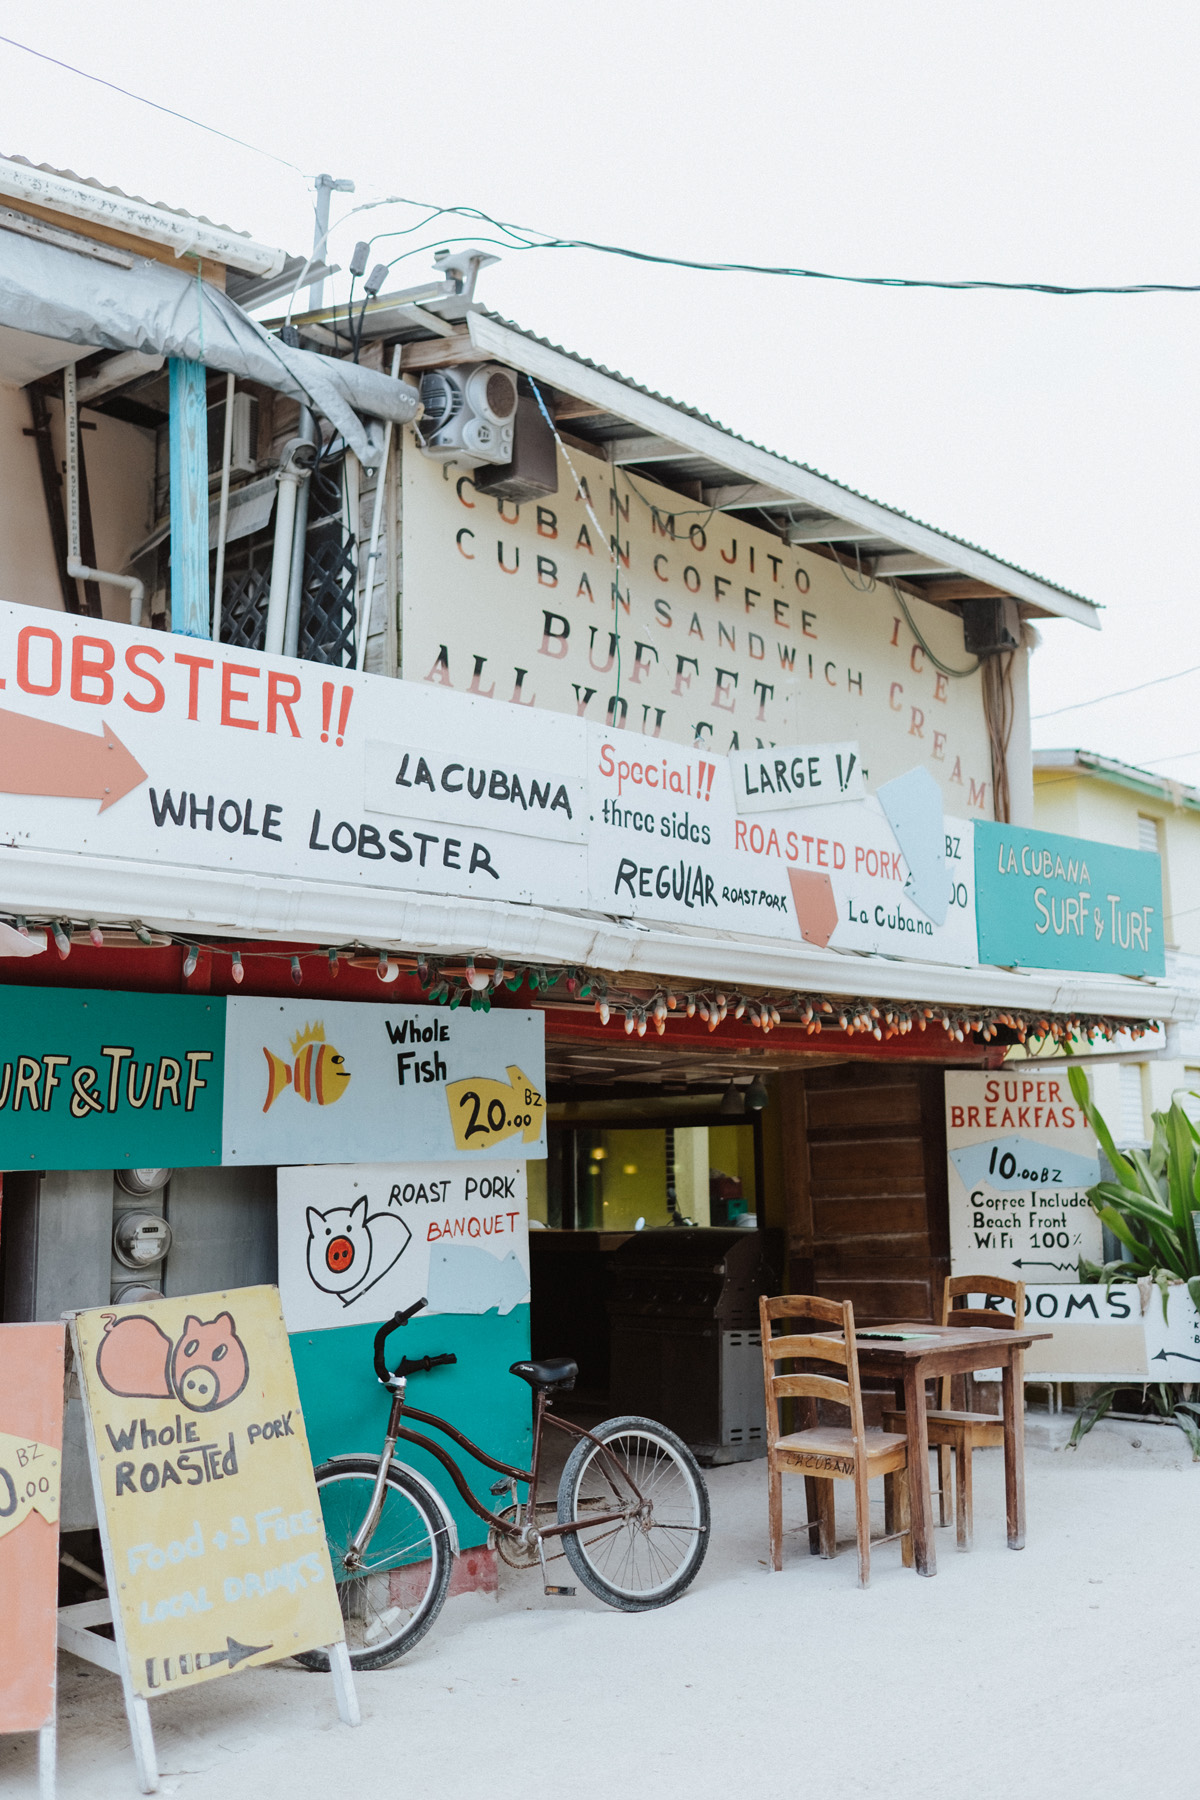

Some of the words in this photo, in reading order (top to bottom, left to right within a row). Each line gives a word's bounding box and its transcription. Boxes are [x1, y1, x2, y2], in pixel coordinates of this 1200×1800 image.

[651, 505, 811, 594] MOJITO
[456, 528, 630, 616] CUBAN
[654, 598, 863, 696] SANDWICH
[653, 553, 818, 640] COFFEE
[890, 616, 950, 704] ICE
[423, 644, 536, 707] ALL
[571, 683, 666, 738] YOU
[889, 682, 986, 809] CREAM
[744, 757, 822, 796] LARGE
[149, 787, 283, 842] WHOLE
[309, 808, 500, 880] LOBSTER
[602, 798, 655, 833] three
[660, 811, 711, 845] sides
[734, 819, 846, 870] ROASTED
[855, 846, 902, 882] PORK
[614, 858, 719, 909] REGULAR
[848, 900, 869, 924] La
[874, 903, 934, 936] Cubana
[1034, 887, 1091, 936] SURF
[1093, 907, 1105, 941] &
[1106, 894, 1154, 952] TURF
[101, 1045, 213, 1113] TURF
[524, 1088, 543, 1107] BZ
[984, 1079, 1063, 1103] SUPER
[459, 1091, 532, 1141] 20.00
[388, 1180, 452, 1207] ROAST
[464, 1176, 516, 1201] PORK
[970, 1190, 1025, 1211] Coffee
[426, 1211, 520, 1242] BANQUET
[973, 1211, 1021, 1228] Beach
[1029, 1211, 1067, 1228] Front
[247, 1410, 295, 1445] PORK
[16, 1443, 44, 1468] BZ
[140, 1586, 213, 1625] LOCAL
[223, 1551, 325, 1603] DRINKS
